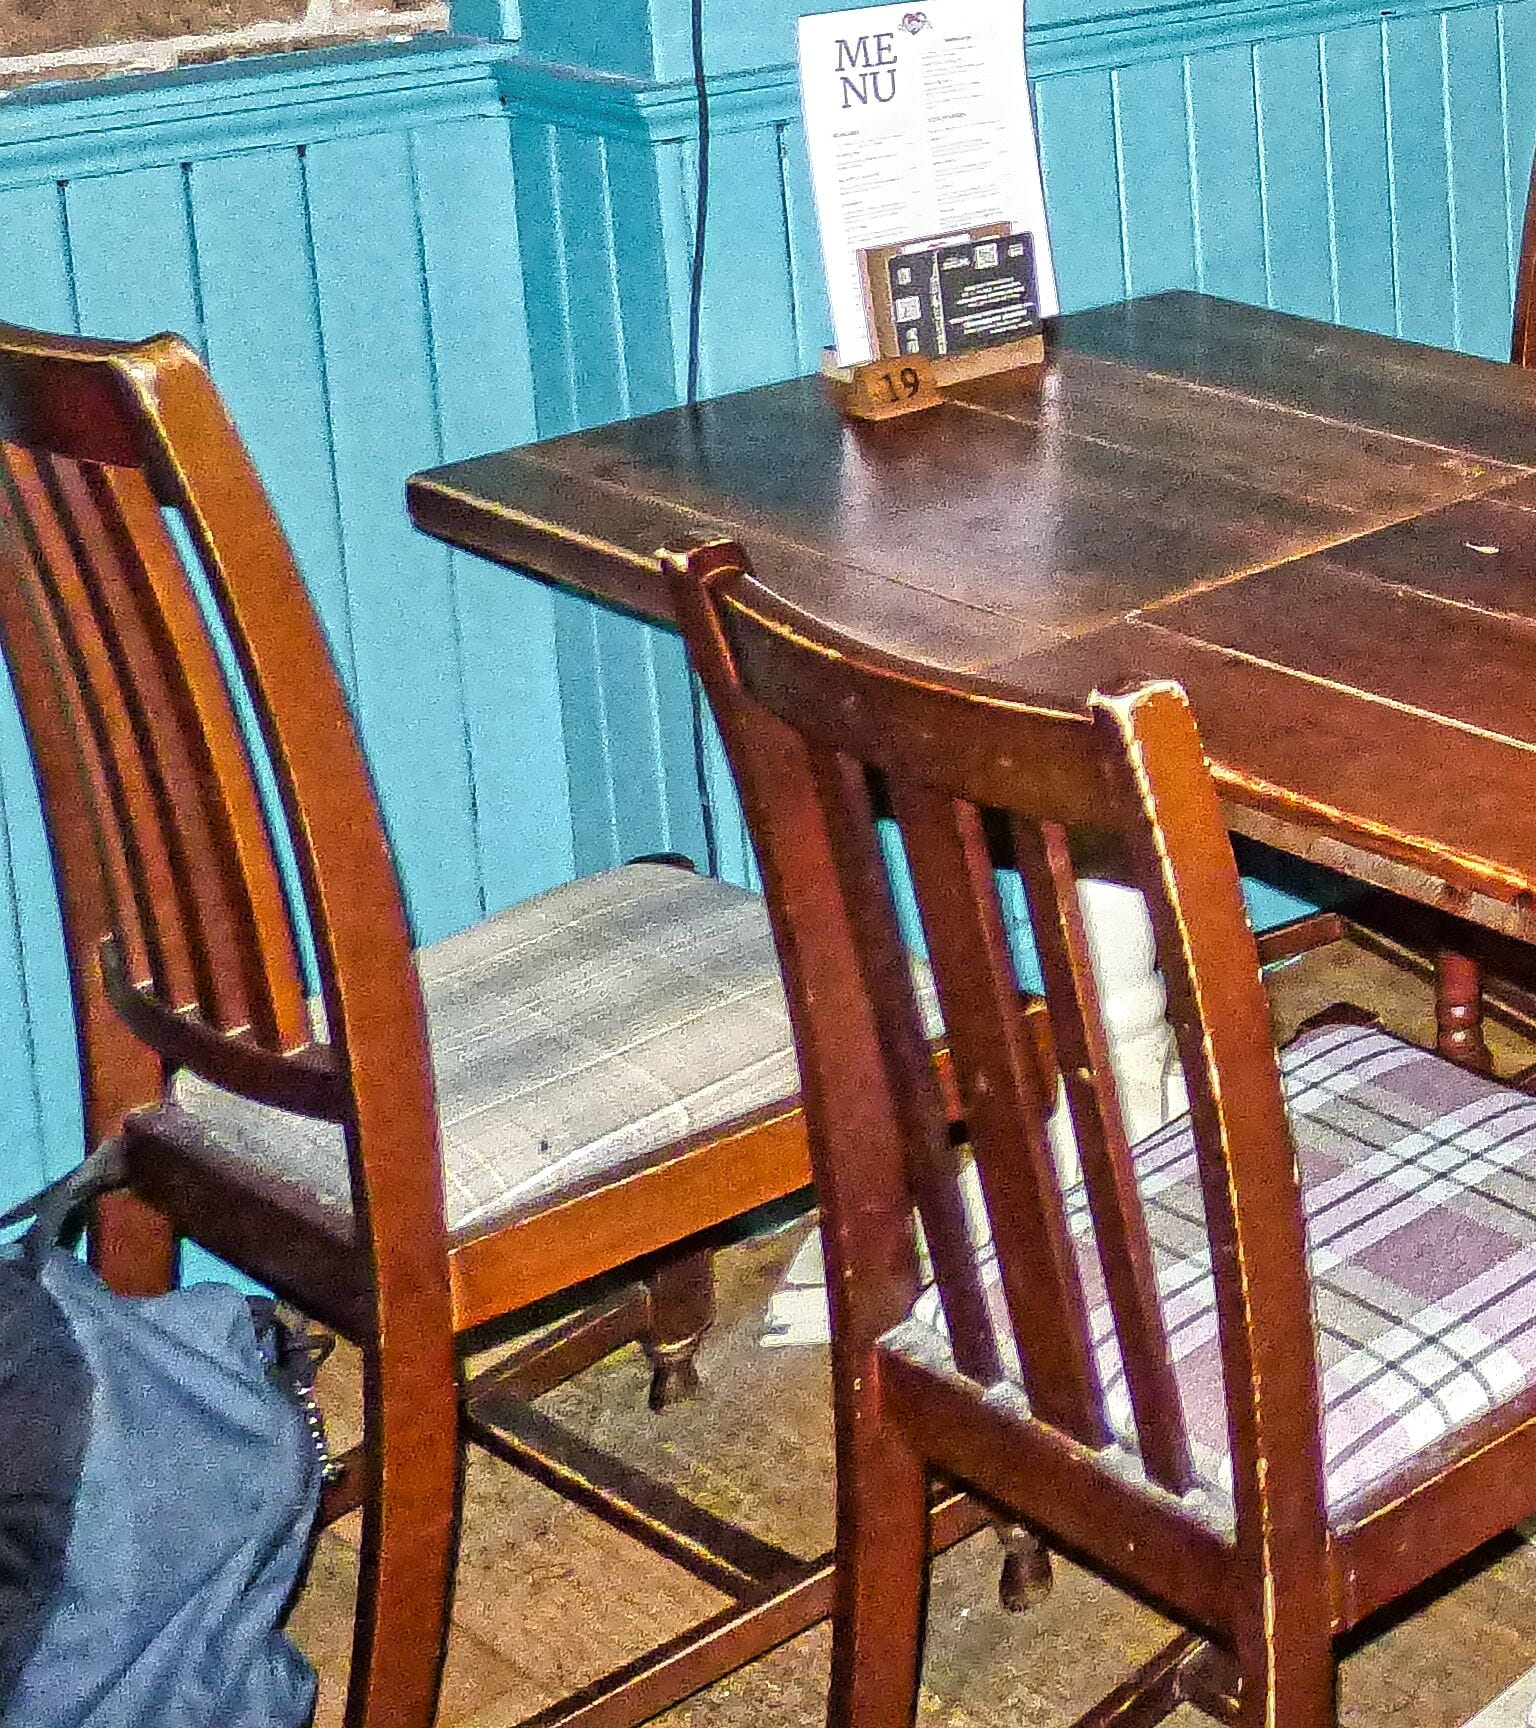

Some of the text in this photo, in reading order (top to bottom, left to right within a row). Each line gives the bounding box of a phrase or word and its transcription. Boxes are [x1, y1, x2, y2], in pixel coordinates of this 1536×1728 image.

[834, 32, 898, 72] ME
[839, 68, 897, 109] NU
[881, 367, 920, 402] 19
